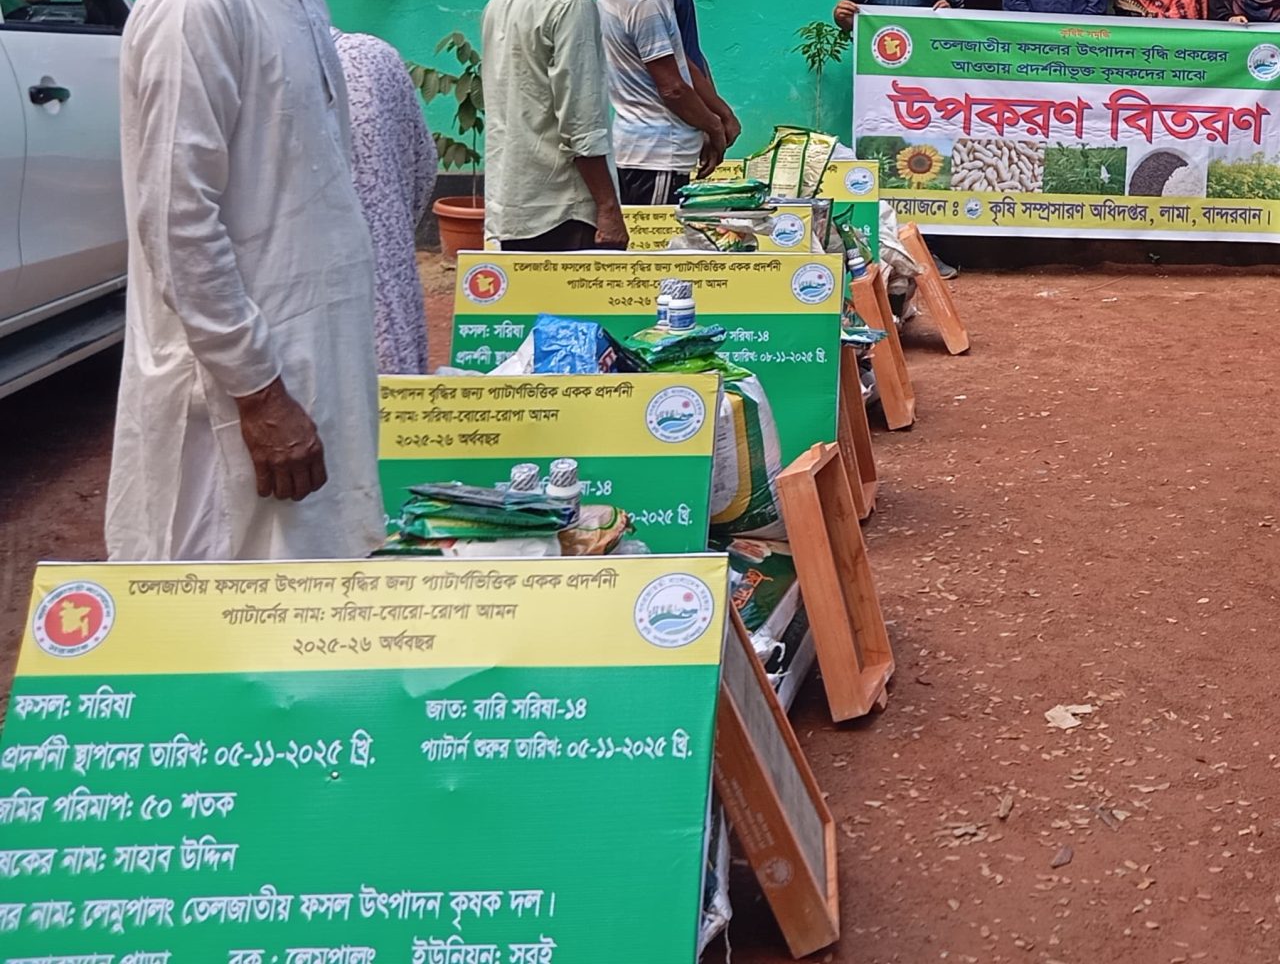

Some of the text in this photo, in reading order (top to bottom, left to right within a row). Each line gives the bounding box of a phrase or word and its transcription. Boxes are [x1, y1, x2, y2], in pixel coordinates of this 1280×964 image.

[931, 37, 1229, 64] তেলজাতীয় ফসলের উৎপাদন বৃদ্ধি প্রকল্পের
[951, 60, 1012, 75] আওতায়
[1100, 66, 1166, 83] কৃষকদের
[1171, 69, 1207, 83] মাঝে
[886, 80, 1270, 145] উপকরণ বিতরণ
[988, 195, 1017, 226] কৃষি
[1021, 201, 1085, 222] সম্প্রসারণ
[493, 320, 525, 338] সরিষা
[396, 434, 453, 447] ২০২৫-২৬
[128, 573, 210, 595] তেলজাতীয়
[215, 579, 271, 595] ফসলের
[275, 573, 337, 594] উৎপাদন
[341, 571, 381, 597] বৃদ্ধির
[385, 576, 417, 591] জন্য
[522, 574, 563, 590] একক
[566, 568, 619, 590] প্রদর্শনী
[476, 604, 518, 620] আমন
[293, 637, 372, 655] ২০২৫-২৬
[78, 685, 136, 719] সরিষা
[473, 692, 508, 720] বারি
[511, 692, 587, 720] সরিষা-১৪
[2, 734, 70, 772] প্রদর্শনী
[73, 742, 145, 776] স্থাপনের
[214, 739, 343, 769] ০৫-১১-২০২৫
[141, 795, 172, 820] ৫০
[181, 791, 237, 818] শতক
[113, 844, 175, 873] সাহাব
[181, 834, 240, 872] উদ্দিন
[81, 897, 175, 934] লেমুপালং
[182, 884, 295, 925] তেলজাতীয়
[300, 893, 354, 921] ফসল
[359, 884, 444, 920] উৎপাদন
[450, 891, 504, 930] কৃষক
